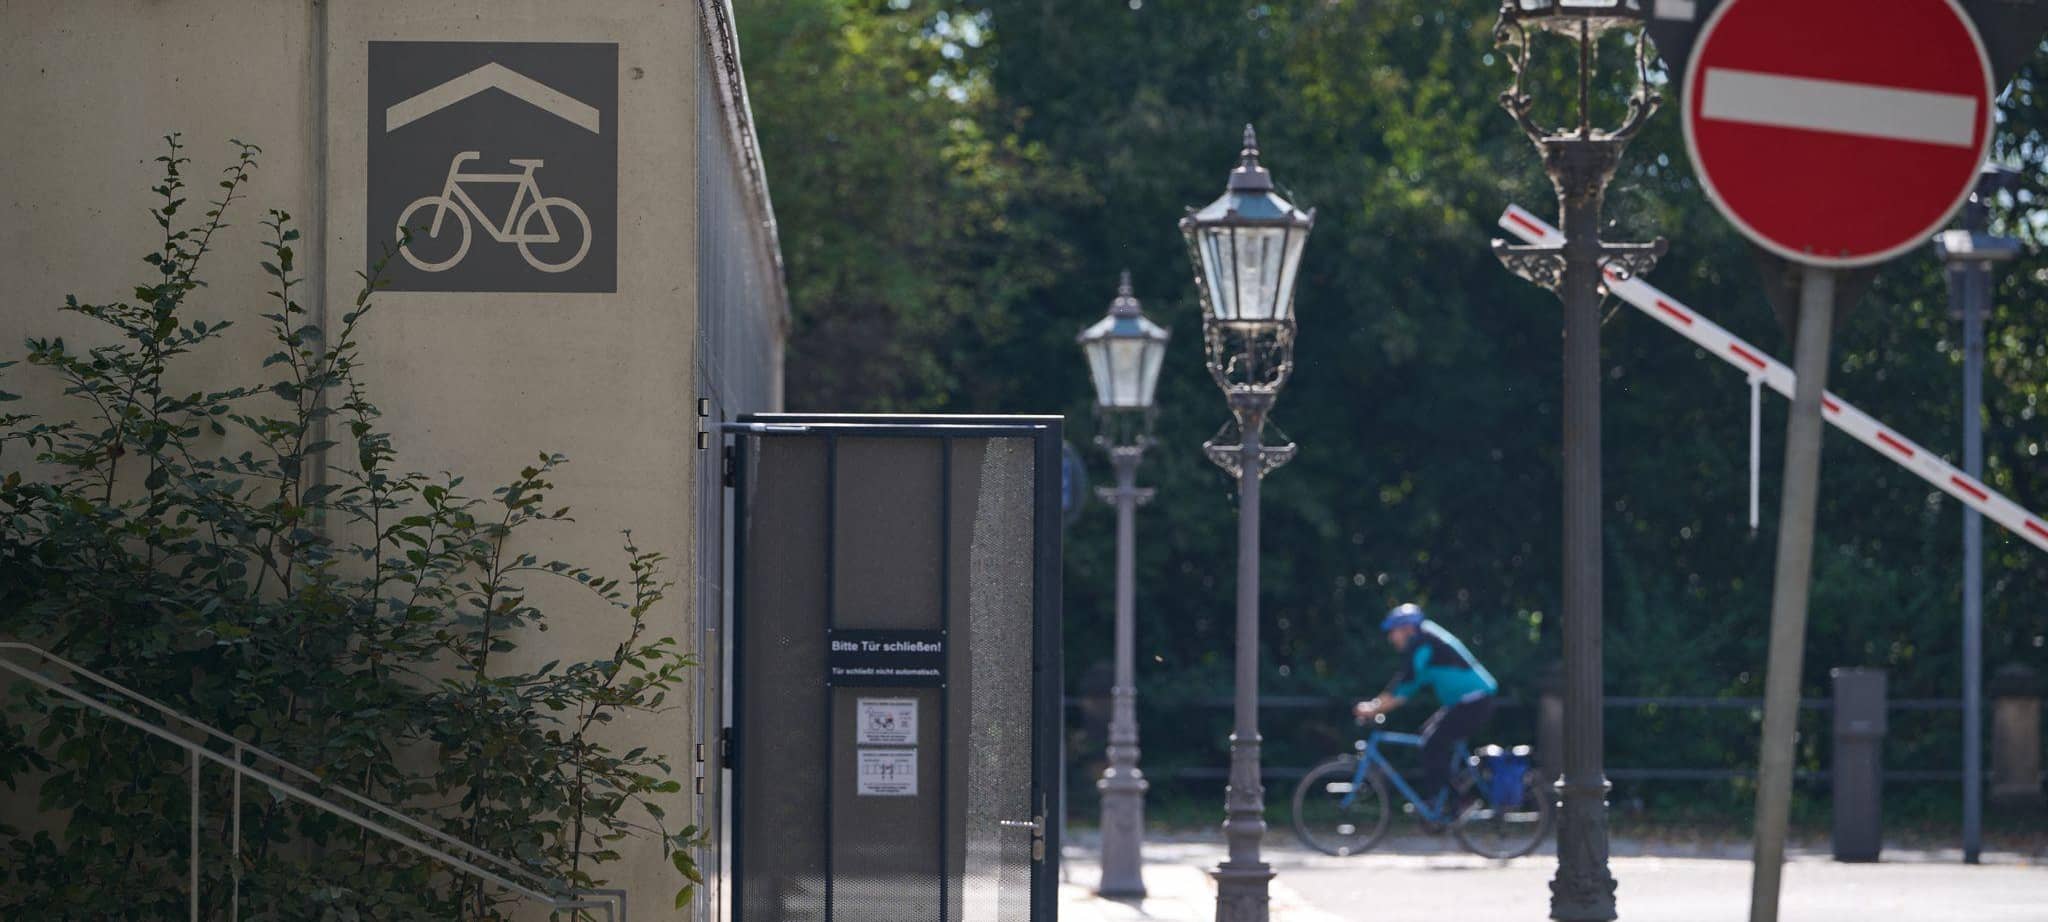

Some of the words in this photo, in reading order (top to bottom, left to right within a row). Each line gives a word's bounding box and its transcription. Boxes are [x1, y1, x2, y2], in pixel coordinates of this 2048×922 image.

[832, 640, 858, 652] Bitte
[861, 640, 880, 652] Tür
[883, 641, 941, 653] schließen!
[832, 667, 844, 675] Tür
[846, 667, 874, 675] schließt
[876, 667, 894, 675] nicht
